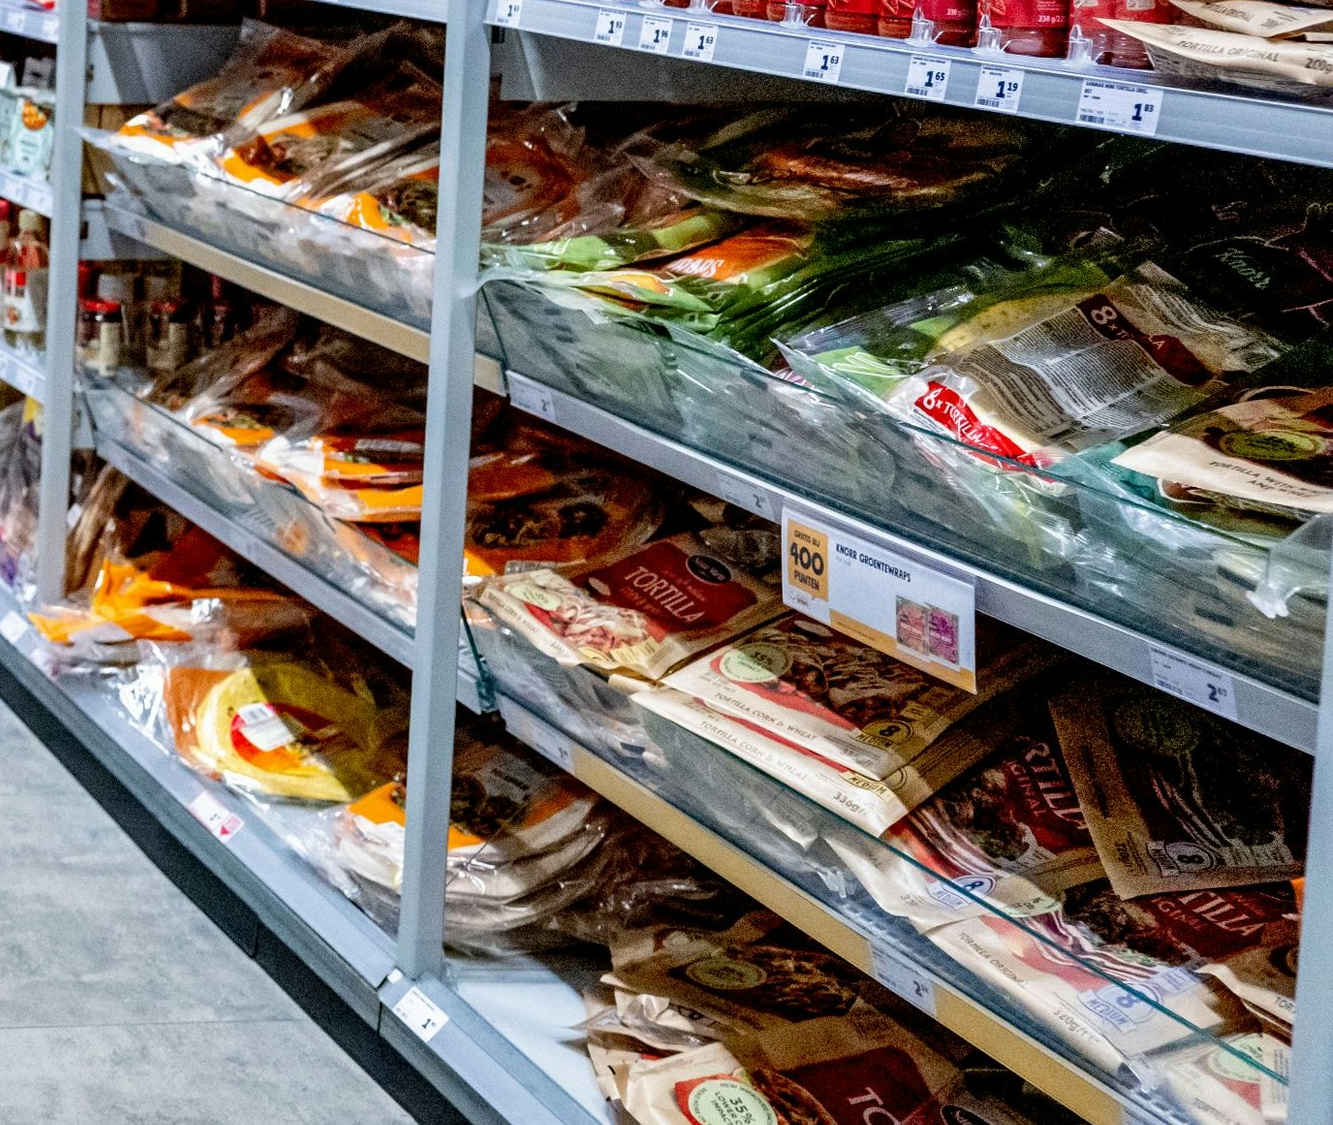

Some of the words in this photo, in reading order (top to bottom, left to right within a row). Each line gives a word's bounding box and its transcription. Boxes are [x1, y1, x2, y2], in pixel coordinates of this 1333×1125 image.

[820, 54, 840, 72] 163
[1177, 39, 1225, 56] TORTILLA
[1229, 46, 1279, 63] ORIGINAL
[925, 70, 947, 88] 165
[996, 80, 1020, 99] 119
[1131, 103, 1155, 123] 183
[794, 529, 812, 546] GRATIS
[788, 541, 825, 577] 400
[835, 542, 859, 561] KNORR
[858, 551, 913, 584] GROENTEWRAPS
[793, 569, 821, 593] PUNTEN
[623, 565, 706, 624] TORTILLA
[714, 691, 751, 717] TORTILLA
[751, 709, 775, 725] CORN
[786, 723, 818, 742] WHEAT
[700, 720, 738, 745] TORTILLA
[1086, 996, 1132, 1026] MEDIUM
[713, 1090, 741, 1117] LOWER
